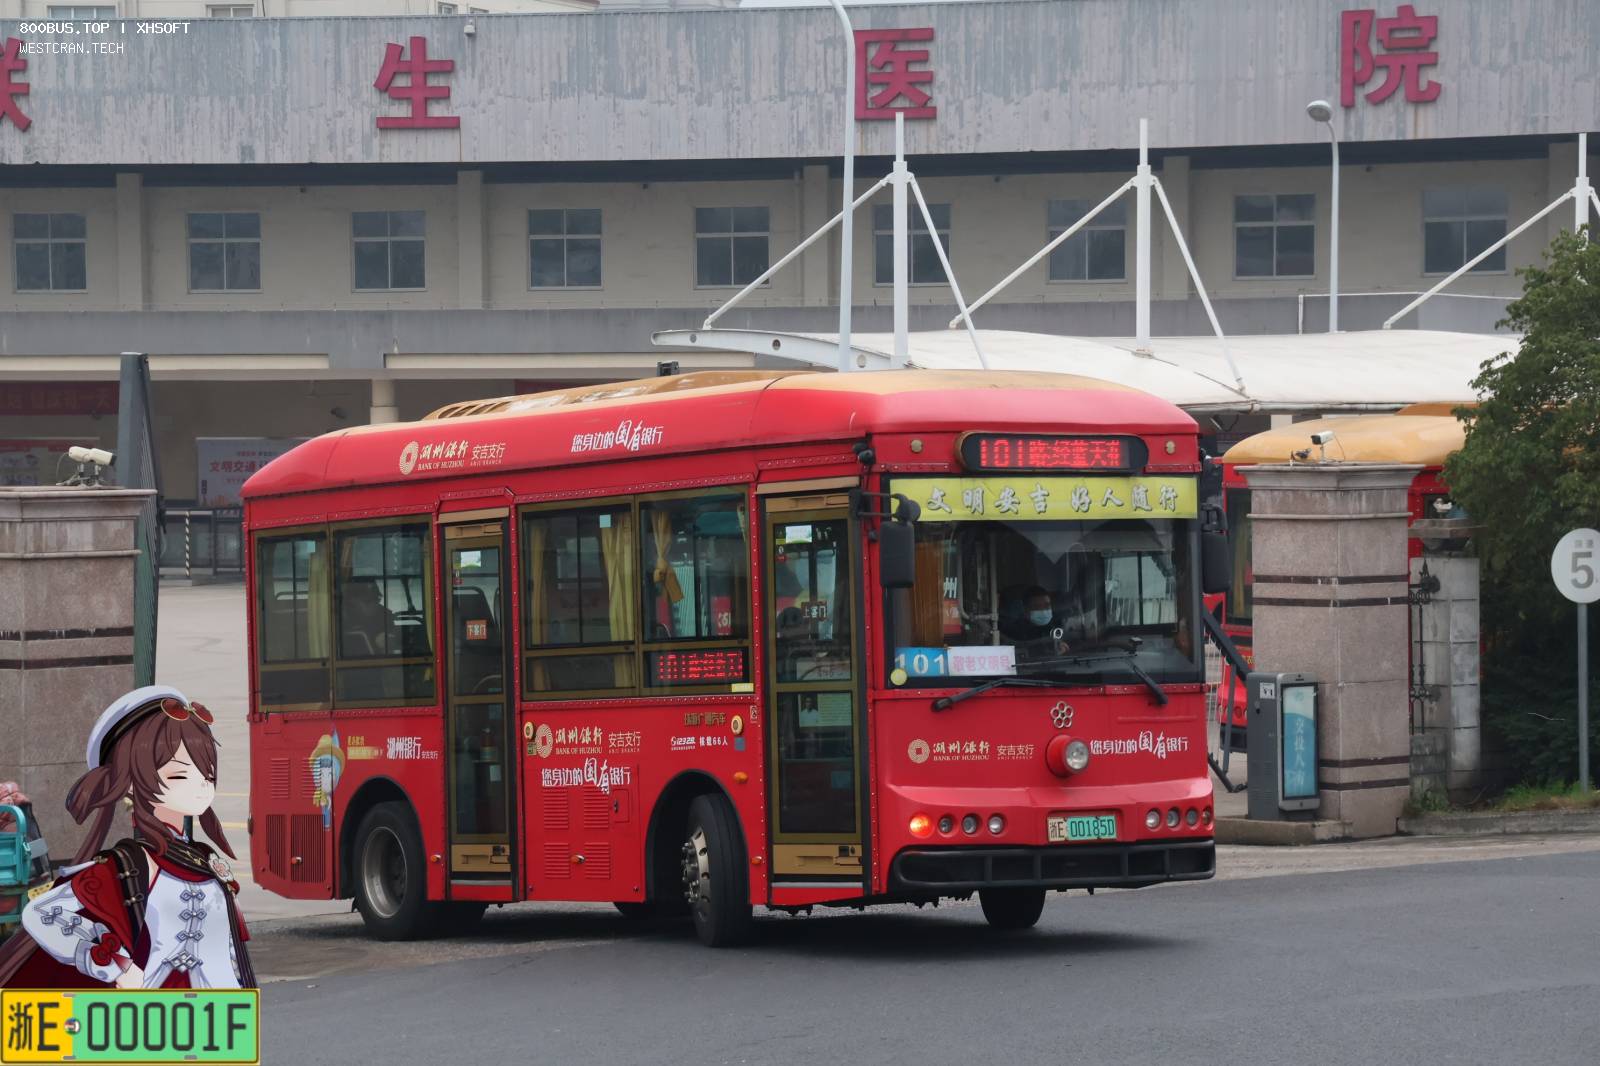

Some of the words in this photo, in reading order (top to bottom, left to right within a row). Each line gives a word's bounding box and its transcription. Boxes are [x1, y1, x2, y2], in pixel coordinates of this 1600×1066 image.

[571, 420, 664, 453] 您身边的国有银行
[420, 440, 468, 460] 湖州银行
[472, 442, 506, 460] 安吉支行
[927, 482, 1050, 515] 文明安吉
[1071, 484, 1178, 513] 好人随行
[1571, 551, 1594, 589] 5
[895, 653, 945, 674] 101
[387, 736, 422, 760] 湖州银行
[556, 726, 603, 745] 湖州银行
[608, 731, 641, 749] 安吉支行
[933, 740, 990, 755] 湖州银行
[997, 744, 1034, 757] 安吉支行
[1090, 730, 1188, 760] 您身边的国有银行
[541, 757, 631, 795] 您身边的国有银行
[1070, 818, 1115, 838] 00185D
